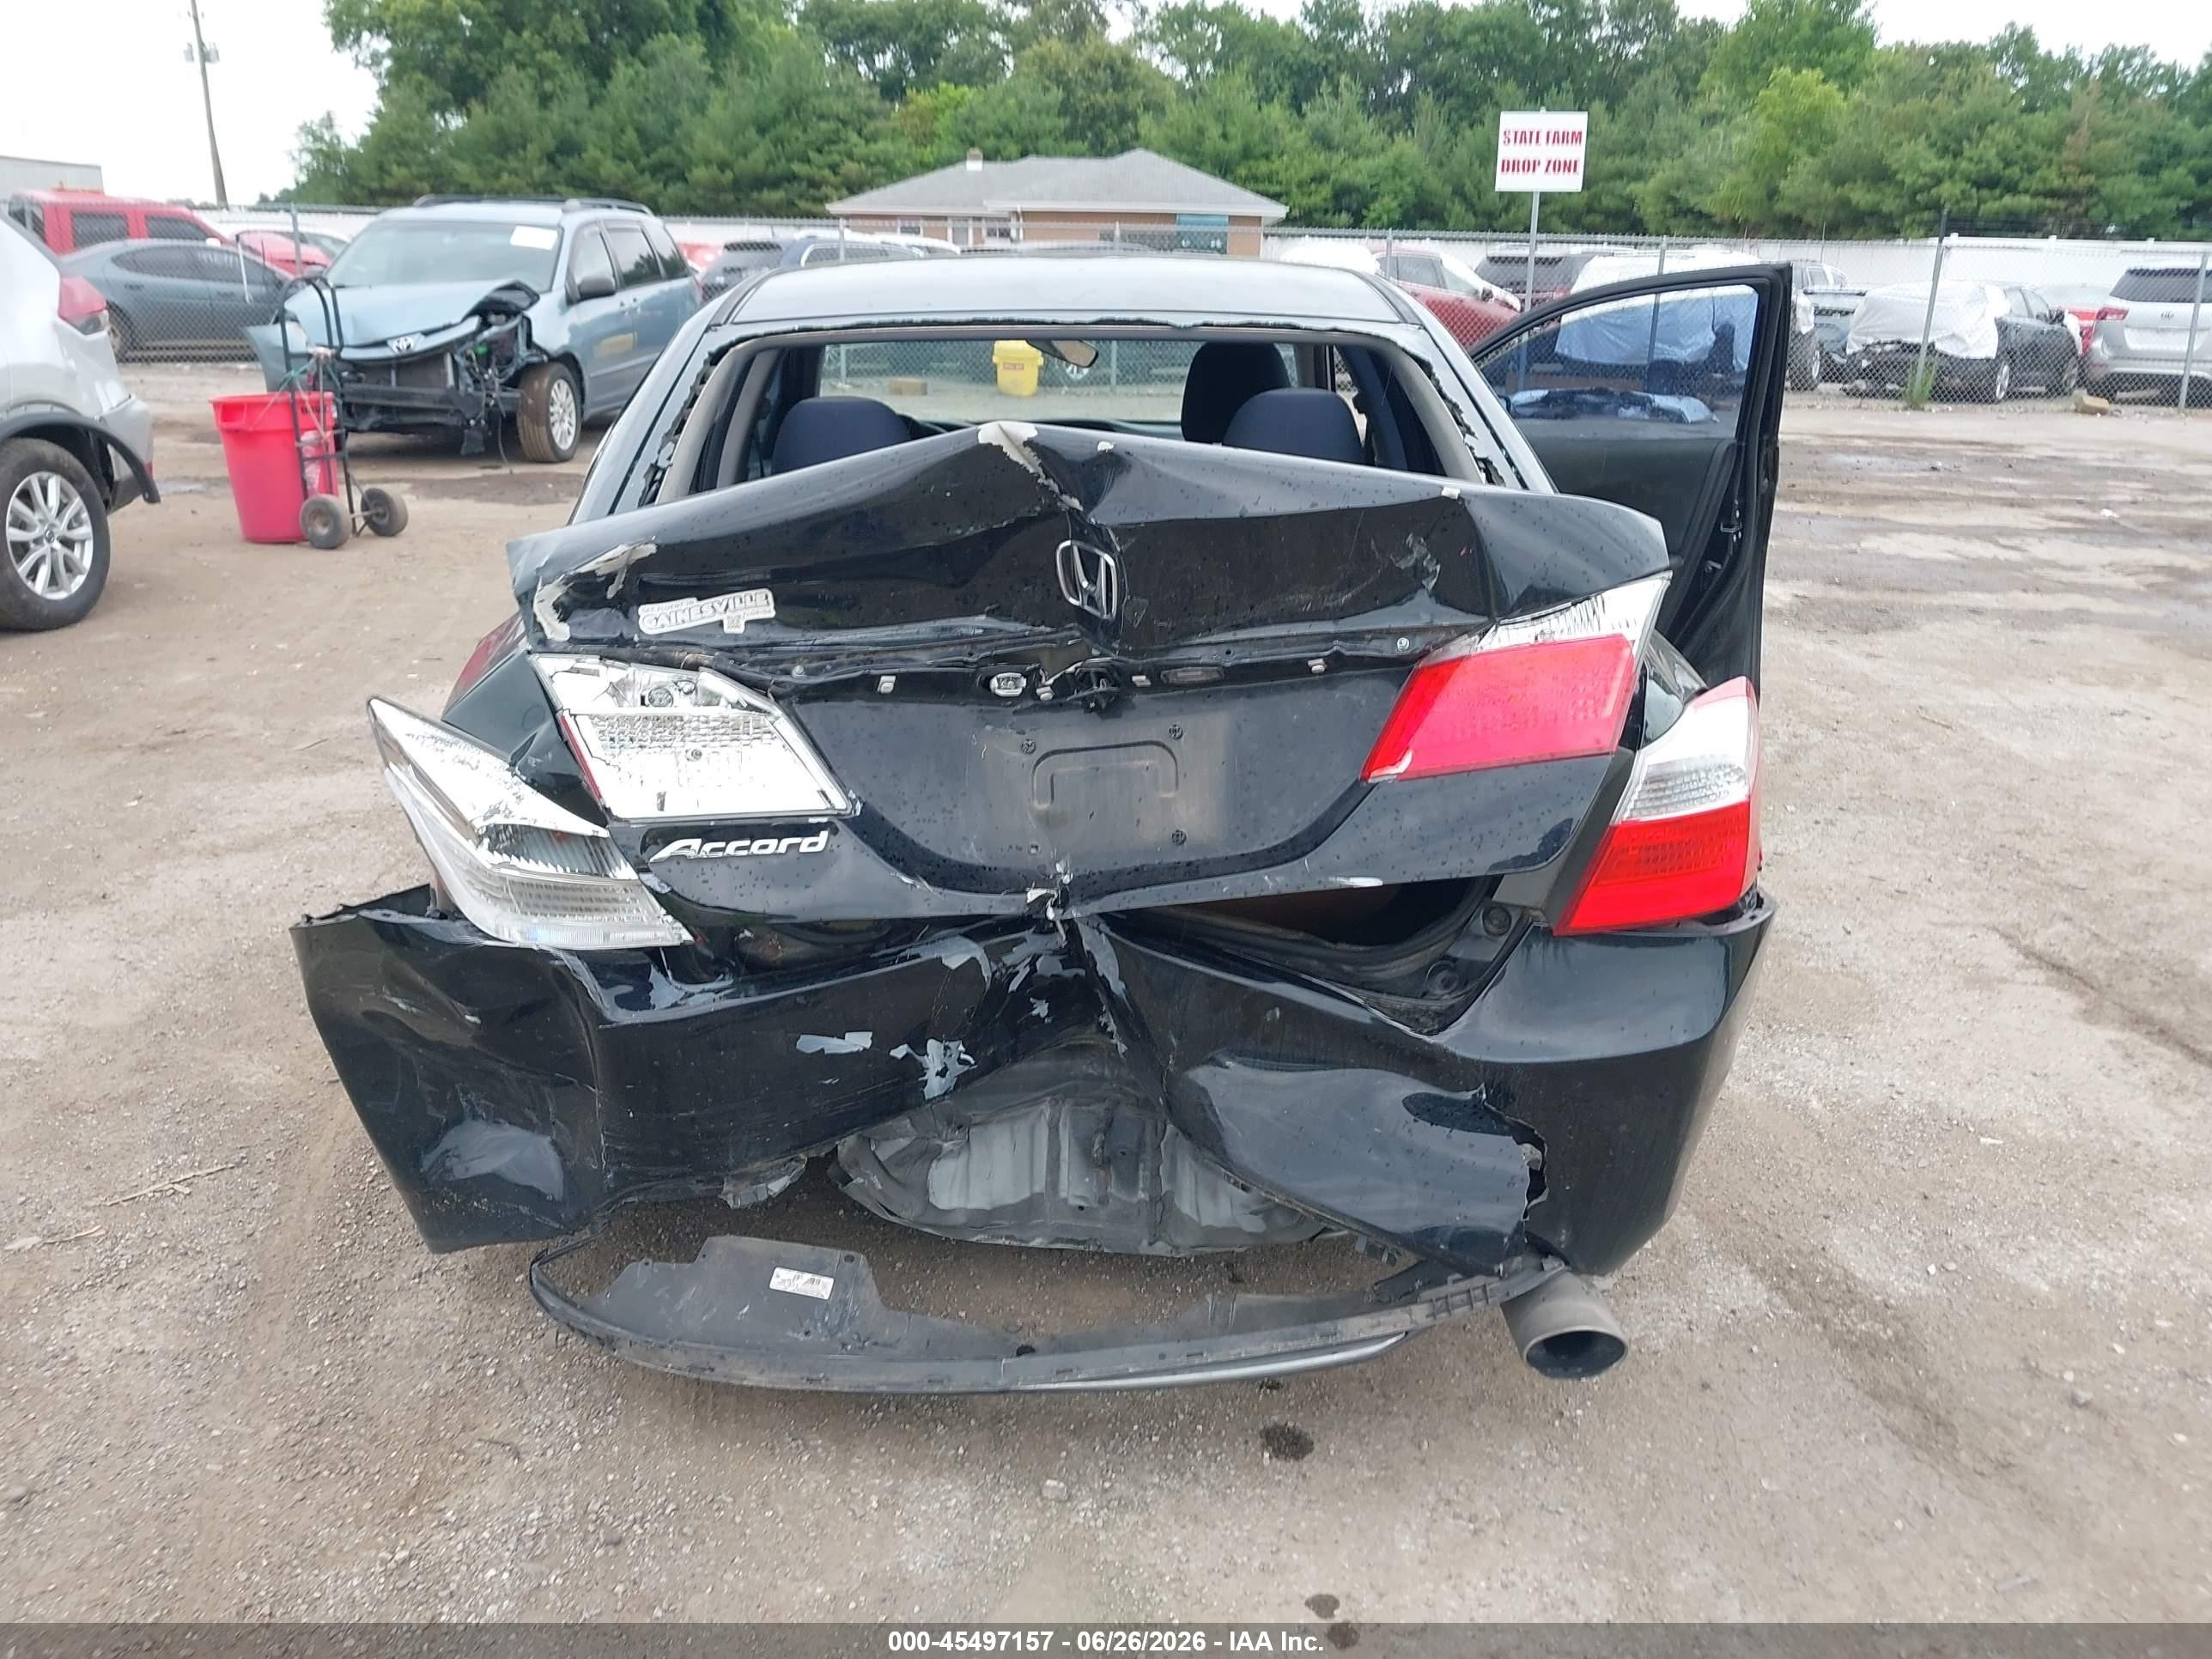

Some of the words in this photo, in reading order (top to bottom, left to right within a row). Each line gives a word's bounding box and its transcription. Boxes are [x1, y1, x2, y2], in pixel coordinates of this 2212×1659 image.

[1503, 129, 1542, 146] STATE
[1545, 129, 1583, 146] FARM
[1500, 158, 1541, 175] DROP
[1544, 158, 1580, 175] ZONE
[642, 592, 770, 629] GAINESVILLE
[648, 830, 830, 864] Accord
